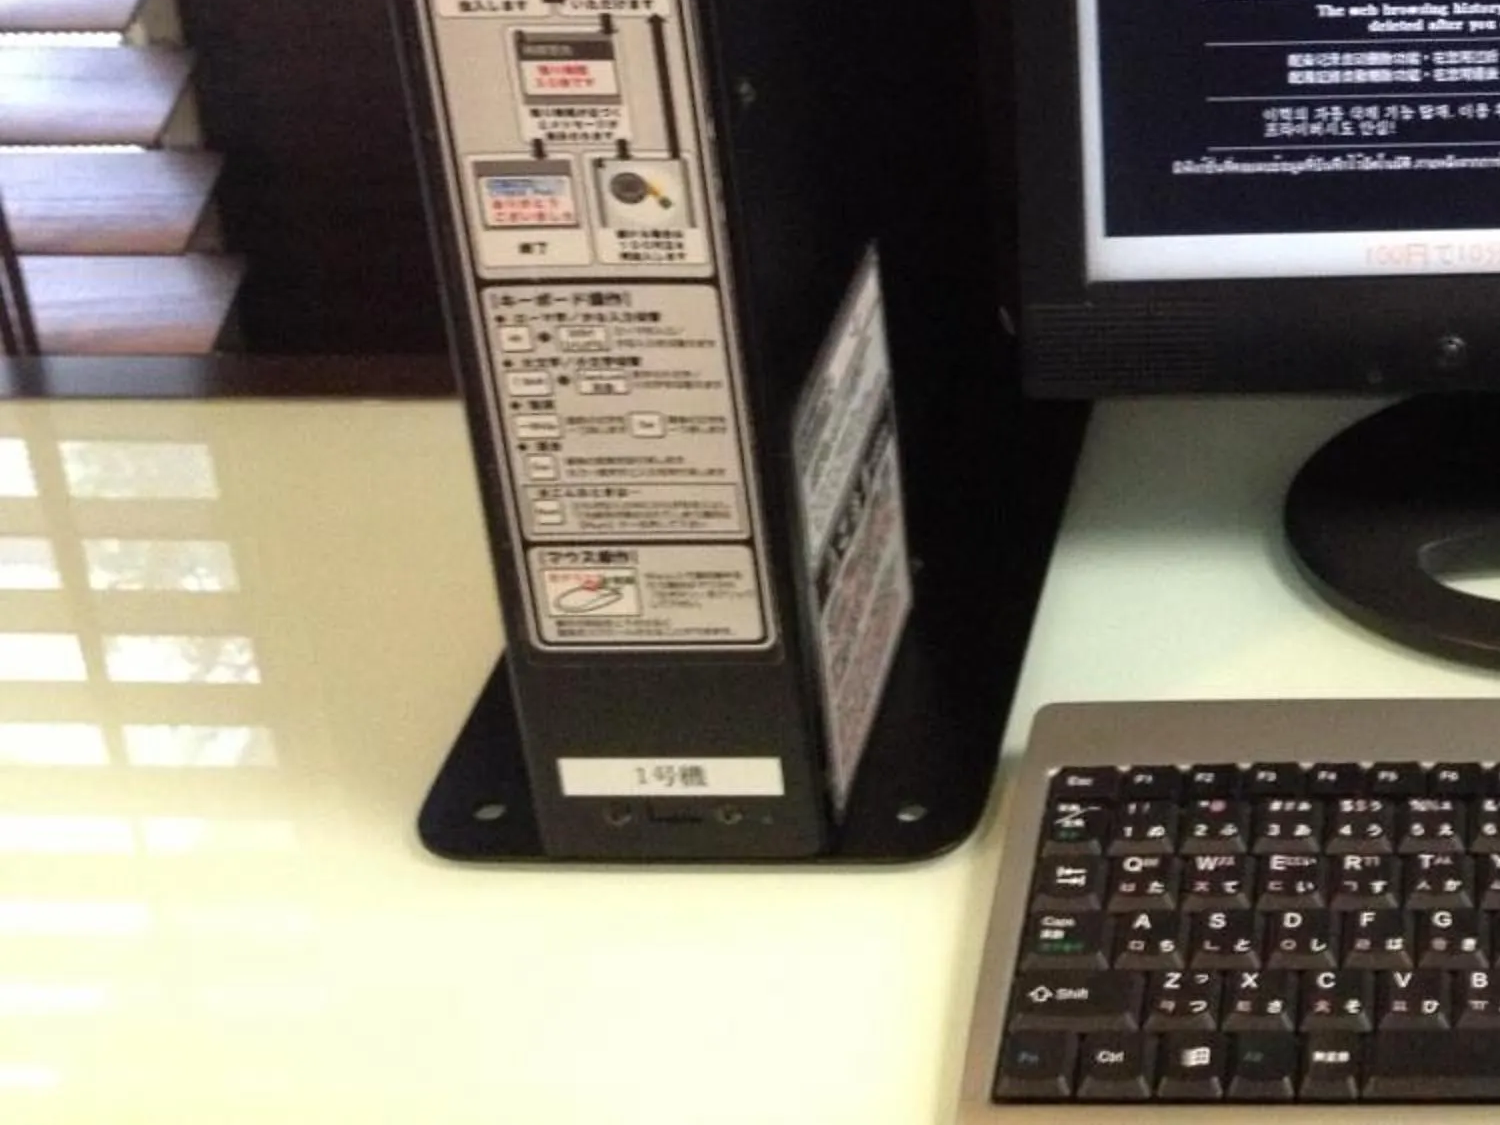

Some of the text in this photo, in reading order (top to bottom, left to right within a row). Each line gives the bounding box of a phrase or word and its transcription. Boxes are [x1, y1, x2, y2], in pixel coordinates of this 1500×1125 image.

[1123, 826, 1133, 838] 1
[1194, 823, 1208, 837] 2
[1267, 823, 1281, 836] 3
[1339, 824, 1352, 836] 4
[1123, 856, 1148, 872] Q
[1196, 856, 1217, 871] W
[1270, 855, 1286, 871] E
[1343, 854, 1363, 870] R
[1418, 853, 1435, 869] T
[1133, 913, 1152, 929] A
[1209, 912, 1227, 929] S
[1283, 912, 1303, 929] D
[1360, 911, 1376, 927] F
[1432, 910, 1453, 928] G
[1163, 971, 1182, 989] Z
[1240, 972, 1259, 988] X
[1316, 971, 1336, 989] C
[1393, 971, 1413, 988] V
[1470, 971, 1489, 989] B
[1055, 987, 1089, 1000] Shift
[1096, 1050, 1125, 1064] Ctrl
